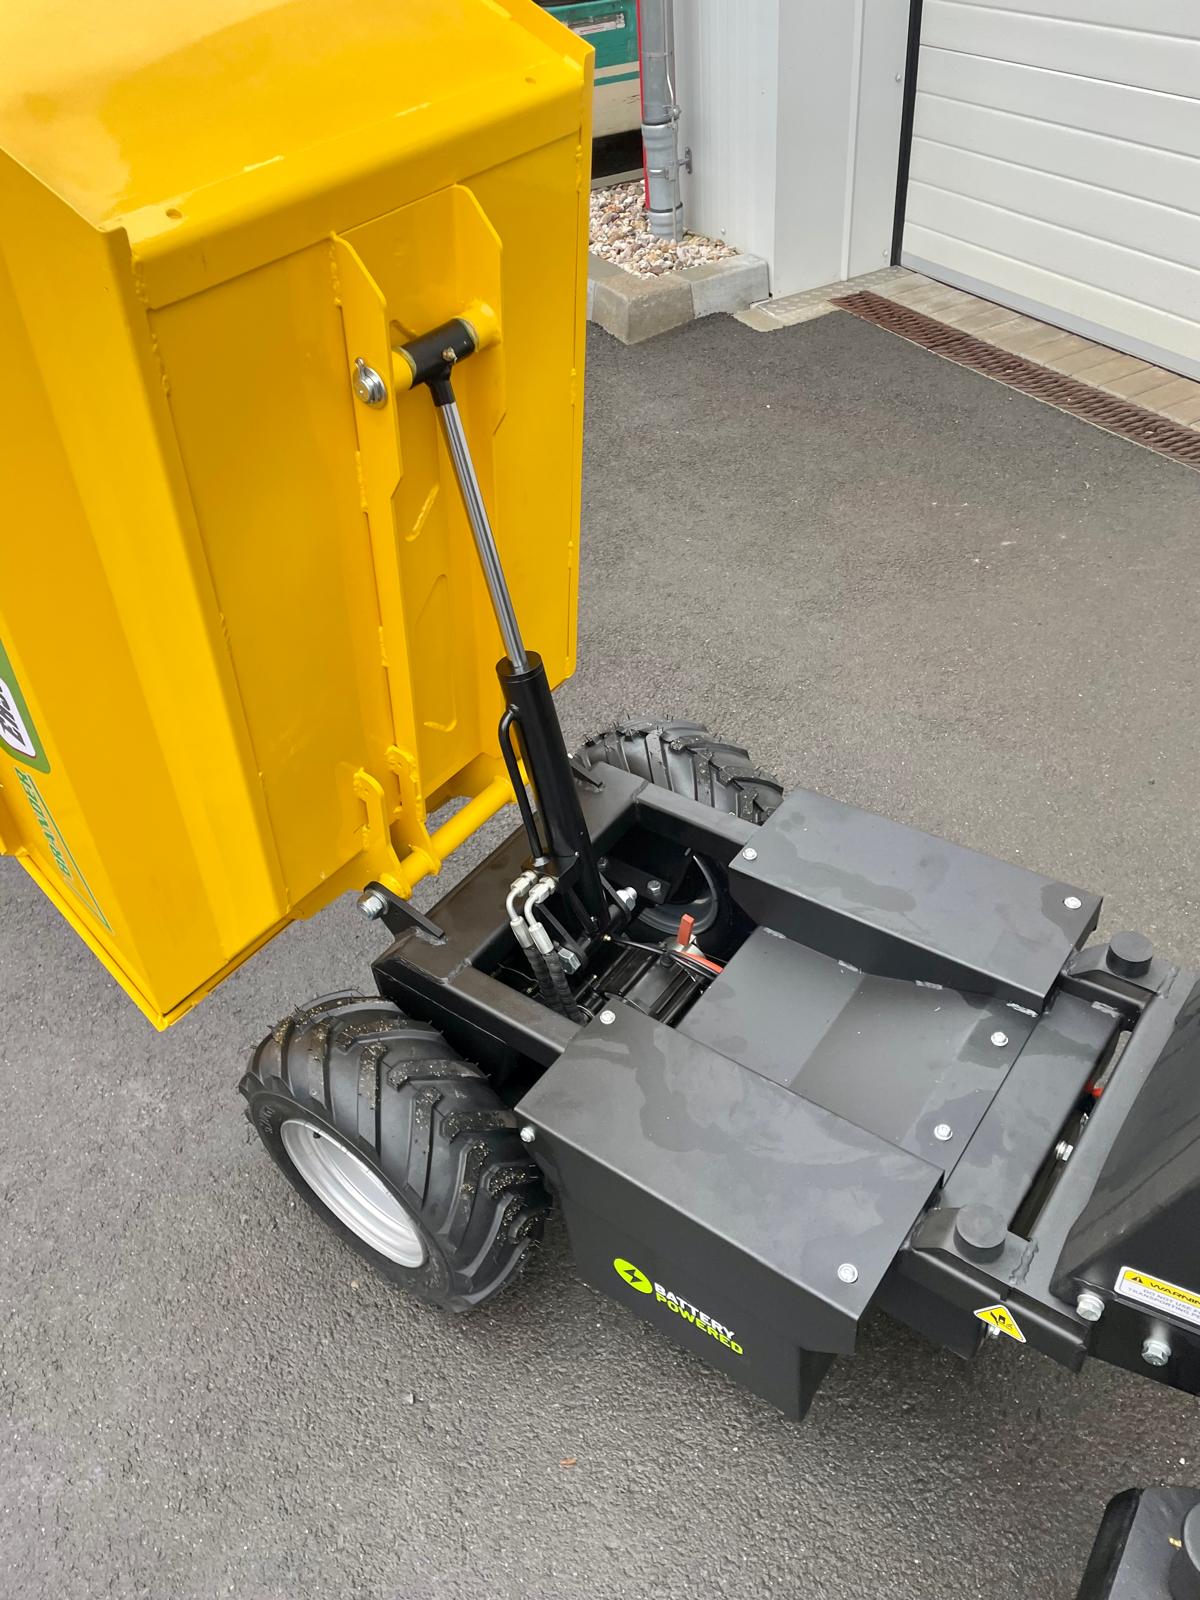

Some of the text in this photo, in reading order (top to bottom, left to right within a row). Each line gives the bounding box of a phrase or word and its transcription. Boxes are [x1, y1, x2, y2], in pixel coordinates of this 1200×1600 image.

[654, 1282, 735, 1339] BATTERY
[1128, 1287, 1190, 1314] TRANSPORTING
[1143, 1289, 1155, 1297] DO
[1157, 1294, 1173, 1303] NOT
[1175, 1301, 1191, 1311] USE
[655, 1292, 743, 1355] POWERED
